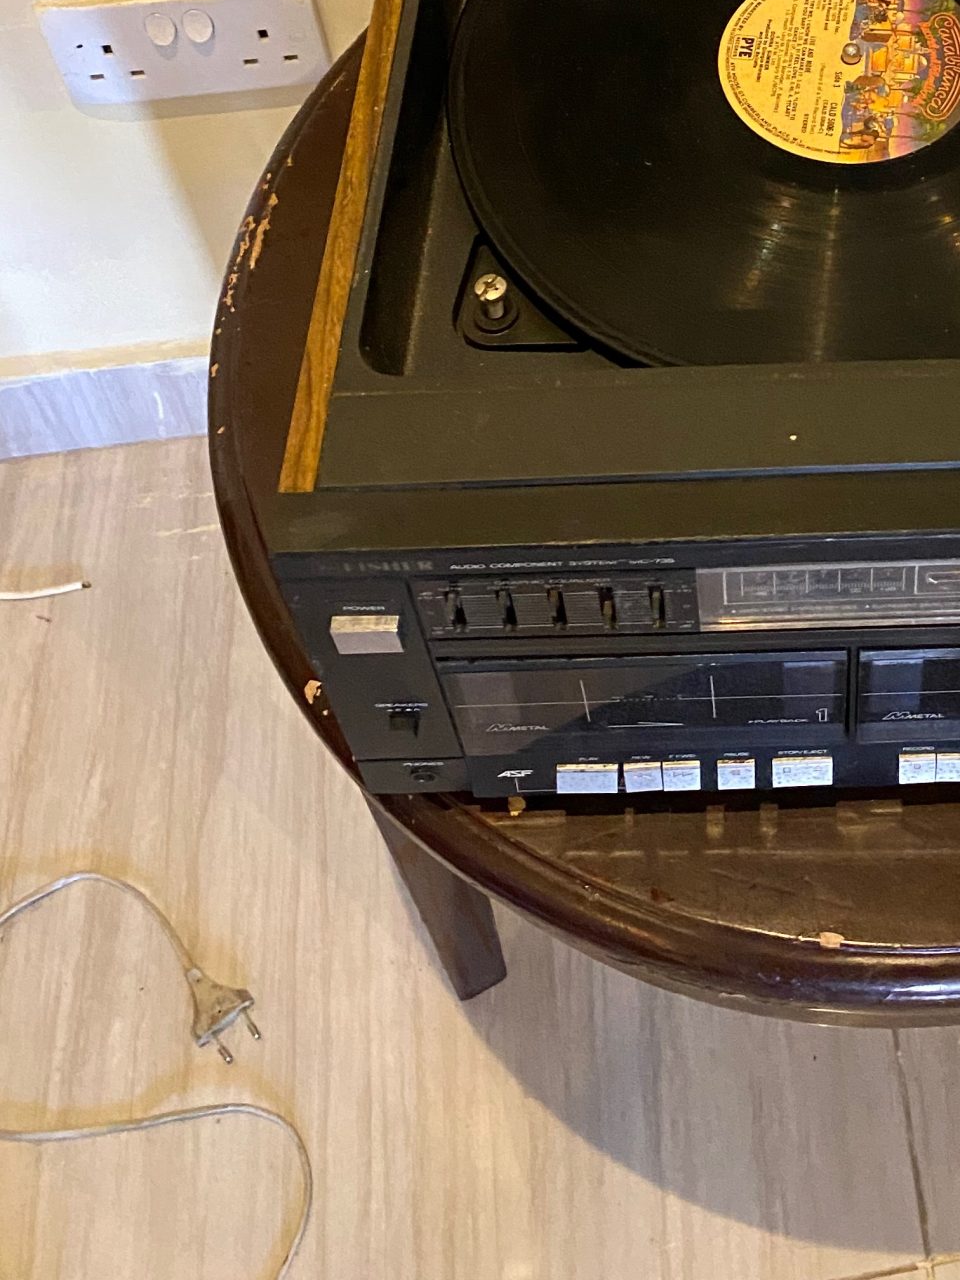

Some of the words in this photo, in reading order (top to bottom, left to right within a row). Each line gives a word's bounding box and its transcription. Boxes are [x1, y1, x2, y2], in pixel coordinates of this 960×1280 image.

[732, 37, 740, 57] RECORDS
[739, 38, 755, 58] PYE
[834, 72, 842, 83] Side
[829, 102, 838, 117] CALD
[489, 561, 564, 569] COMPONENT
[816, 708, 829, 722] 1
